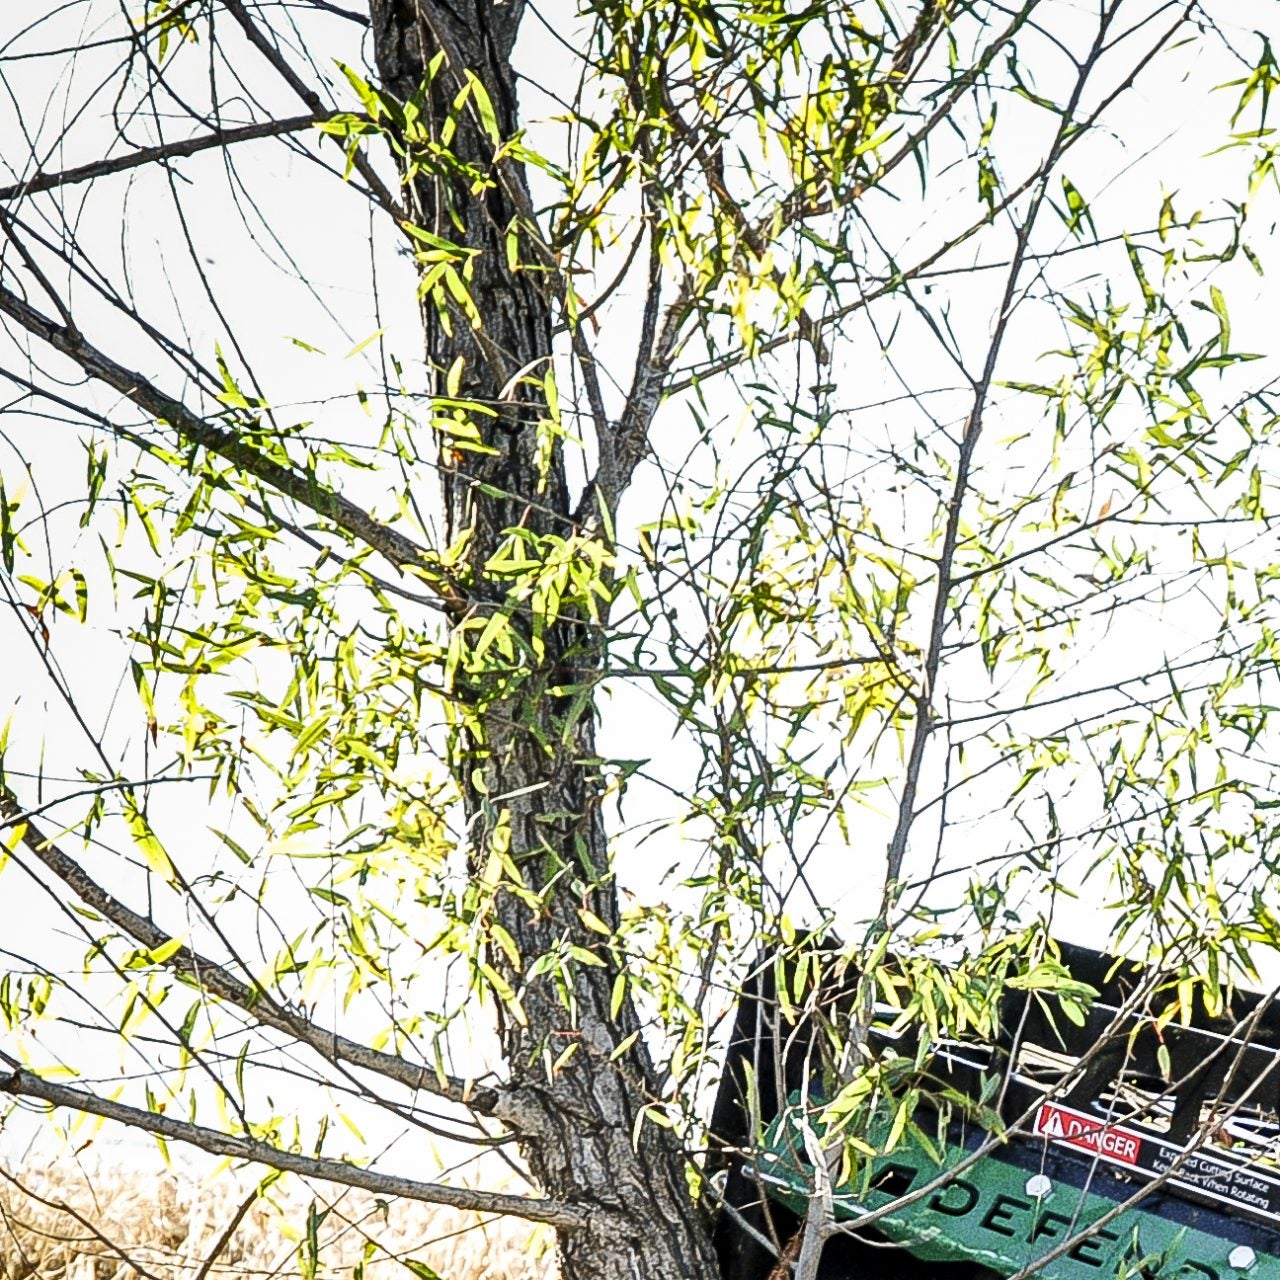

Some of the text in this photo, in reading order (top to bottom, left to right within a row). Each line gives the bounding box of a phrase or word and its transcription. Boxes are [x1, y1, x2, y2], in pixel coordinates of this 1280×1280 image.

[1068, 1120, 1136, 1159] DANGER
[1153, 1160, 1173, 1174] Kee
[1202, 1177, 1228, 1193] When
[1230, 1185, 1270, 1209] Rotating
[1159, 1147, 1198, 1168] Exped
[1235, 1173, 1270, 1193] Surface
